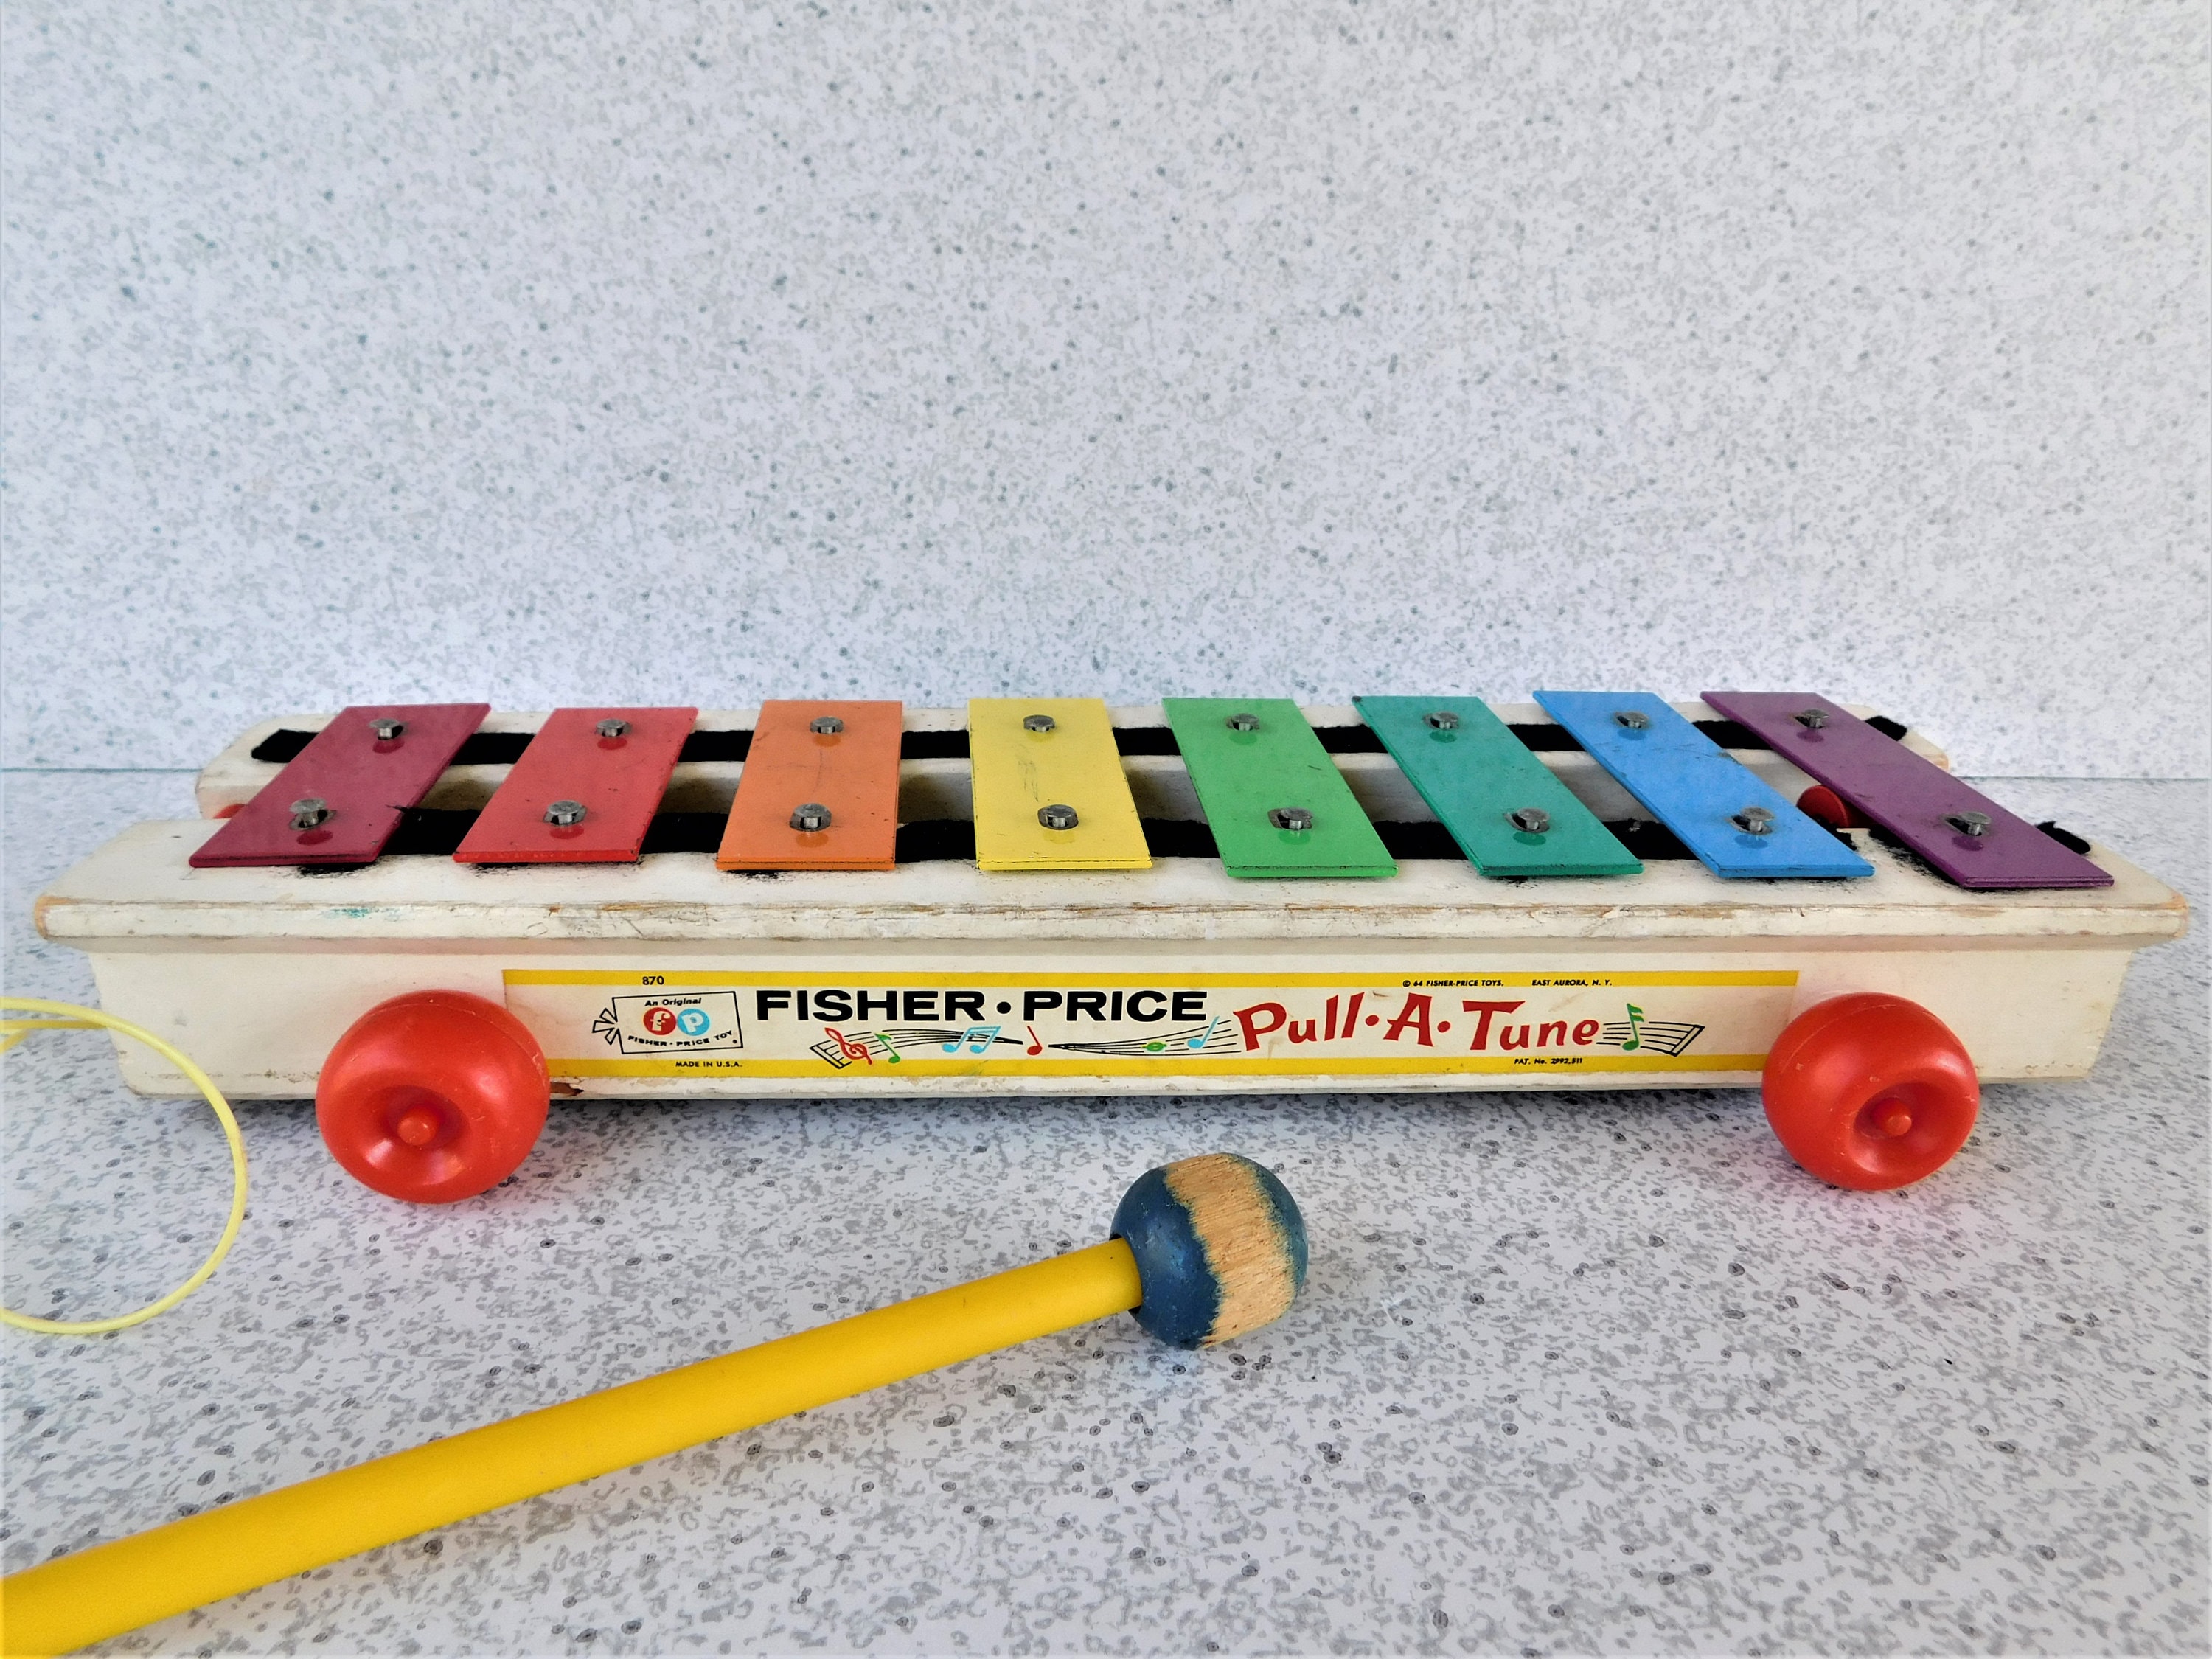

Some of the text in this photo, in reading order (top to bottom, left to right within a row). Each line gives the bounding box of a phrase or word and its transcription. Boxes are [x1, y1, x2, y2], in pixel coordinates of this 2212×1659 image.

[642, 975, 664, 985] 870
[662, 998, 702, 1006] Original
[714, 1030, 732, 1040] TOY
